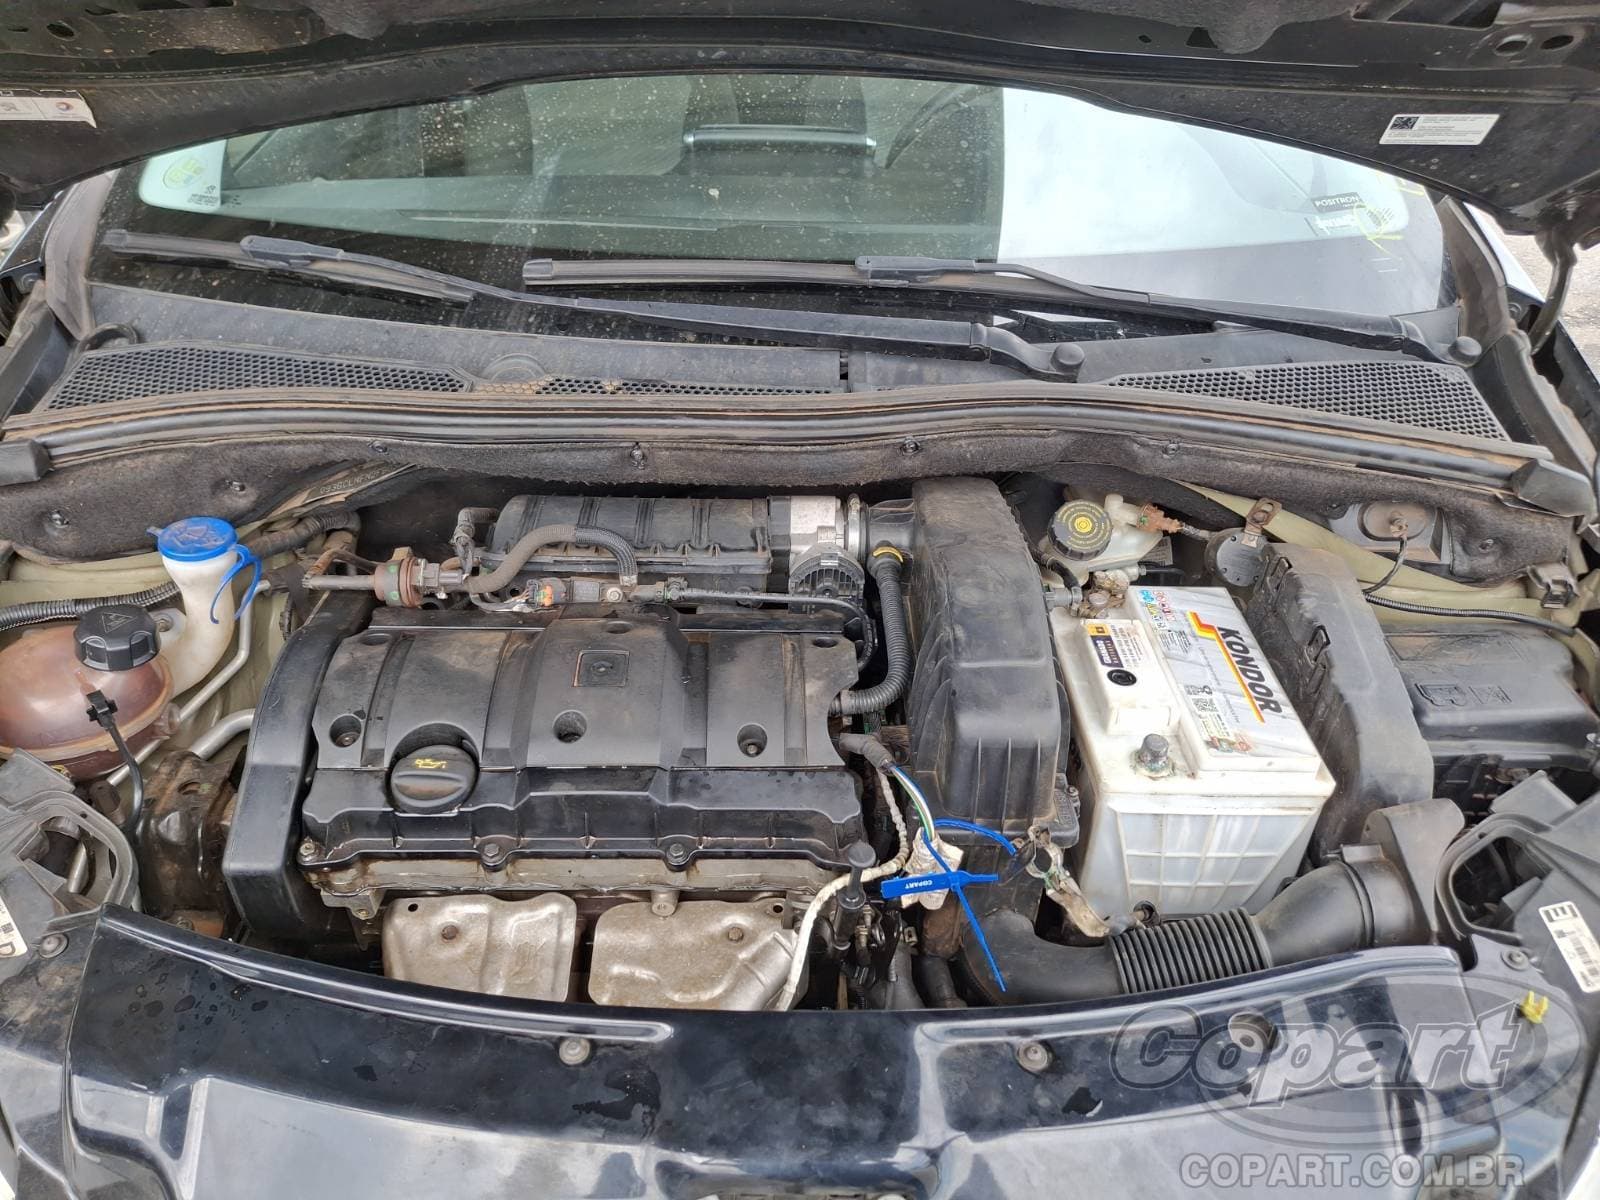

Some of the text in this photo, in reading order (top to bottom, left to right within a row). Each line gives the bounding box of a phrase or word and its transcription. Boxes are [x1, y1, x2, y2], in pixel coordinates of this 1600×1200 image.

[1314, 196, 1359, 207] POSITRON
[1217, 626, 1283, 713] KONDOR
[904, 879, 933, 889] COPART
